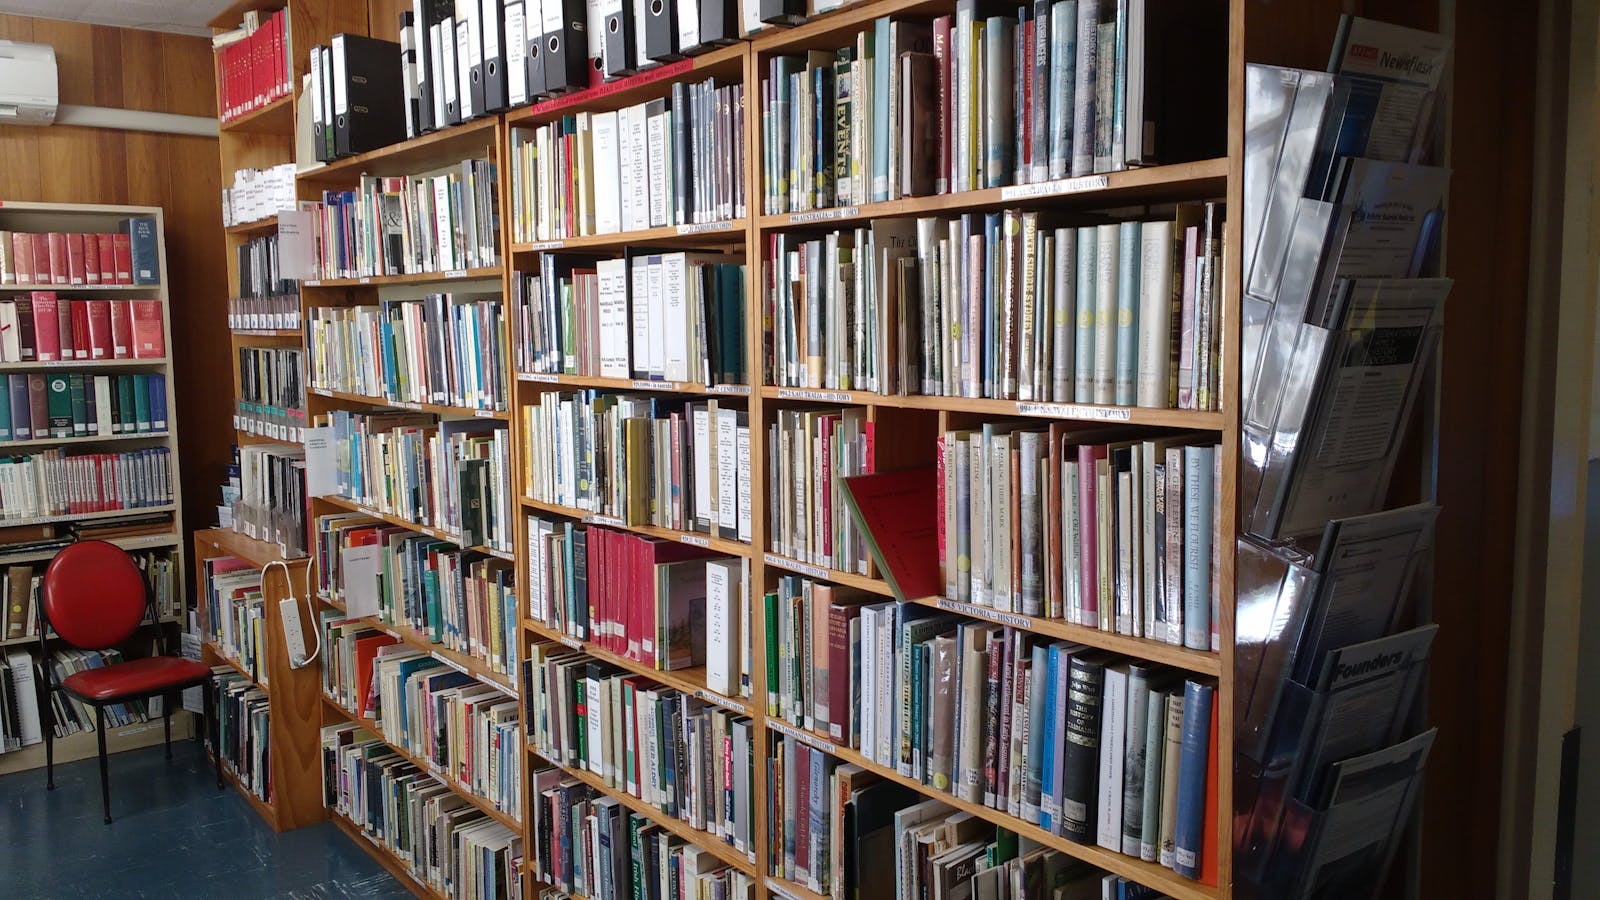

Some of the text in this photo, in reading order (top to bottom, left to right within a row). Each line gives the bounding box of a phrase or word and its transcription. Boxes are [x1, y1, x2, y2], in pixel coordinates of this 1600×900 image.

[1036, 15, 1046, 66] BUSHRANGERS
[1083, 19, 1091, 70] AUSTRALIAN
[836, 105, 846, 176] EVENTS
[799, 212, 828, 221] AUSTRALIA
[1025, 219, 1035, 335] NORTH SHORE SYDNEY
[1189, 457, 1200, 571] BY THESE WE FLOURISH
[805, 565, 827, 578] HISTORY
[956, 603, 992, 619] VICTORIA
[996, 613, 1031, 628] HISTORY
[1005, 662, 1013, 678] Land
[1337, 651, 1403, 679] Founders
[1004, 679, 1012, 715] Settlement
[1016, 669, 1024, 702] CONVICT
[1069, 709, 1094, 720] HISTORY
[1075, 703, 1088, 712] THE
[703, 725, 712, 759] BATTLE
[782, 726, 807, 742] TASMANIA
[1002, 723, 1011, 740] Early
[1022, 711, 1030, 745] TASMANIA
[1067, 721, 1096, 735] TASMANIA
[650, 741, 658, 789] HERALDRY
[1000, 741, 1009, 773] Tasmania
